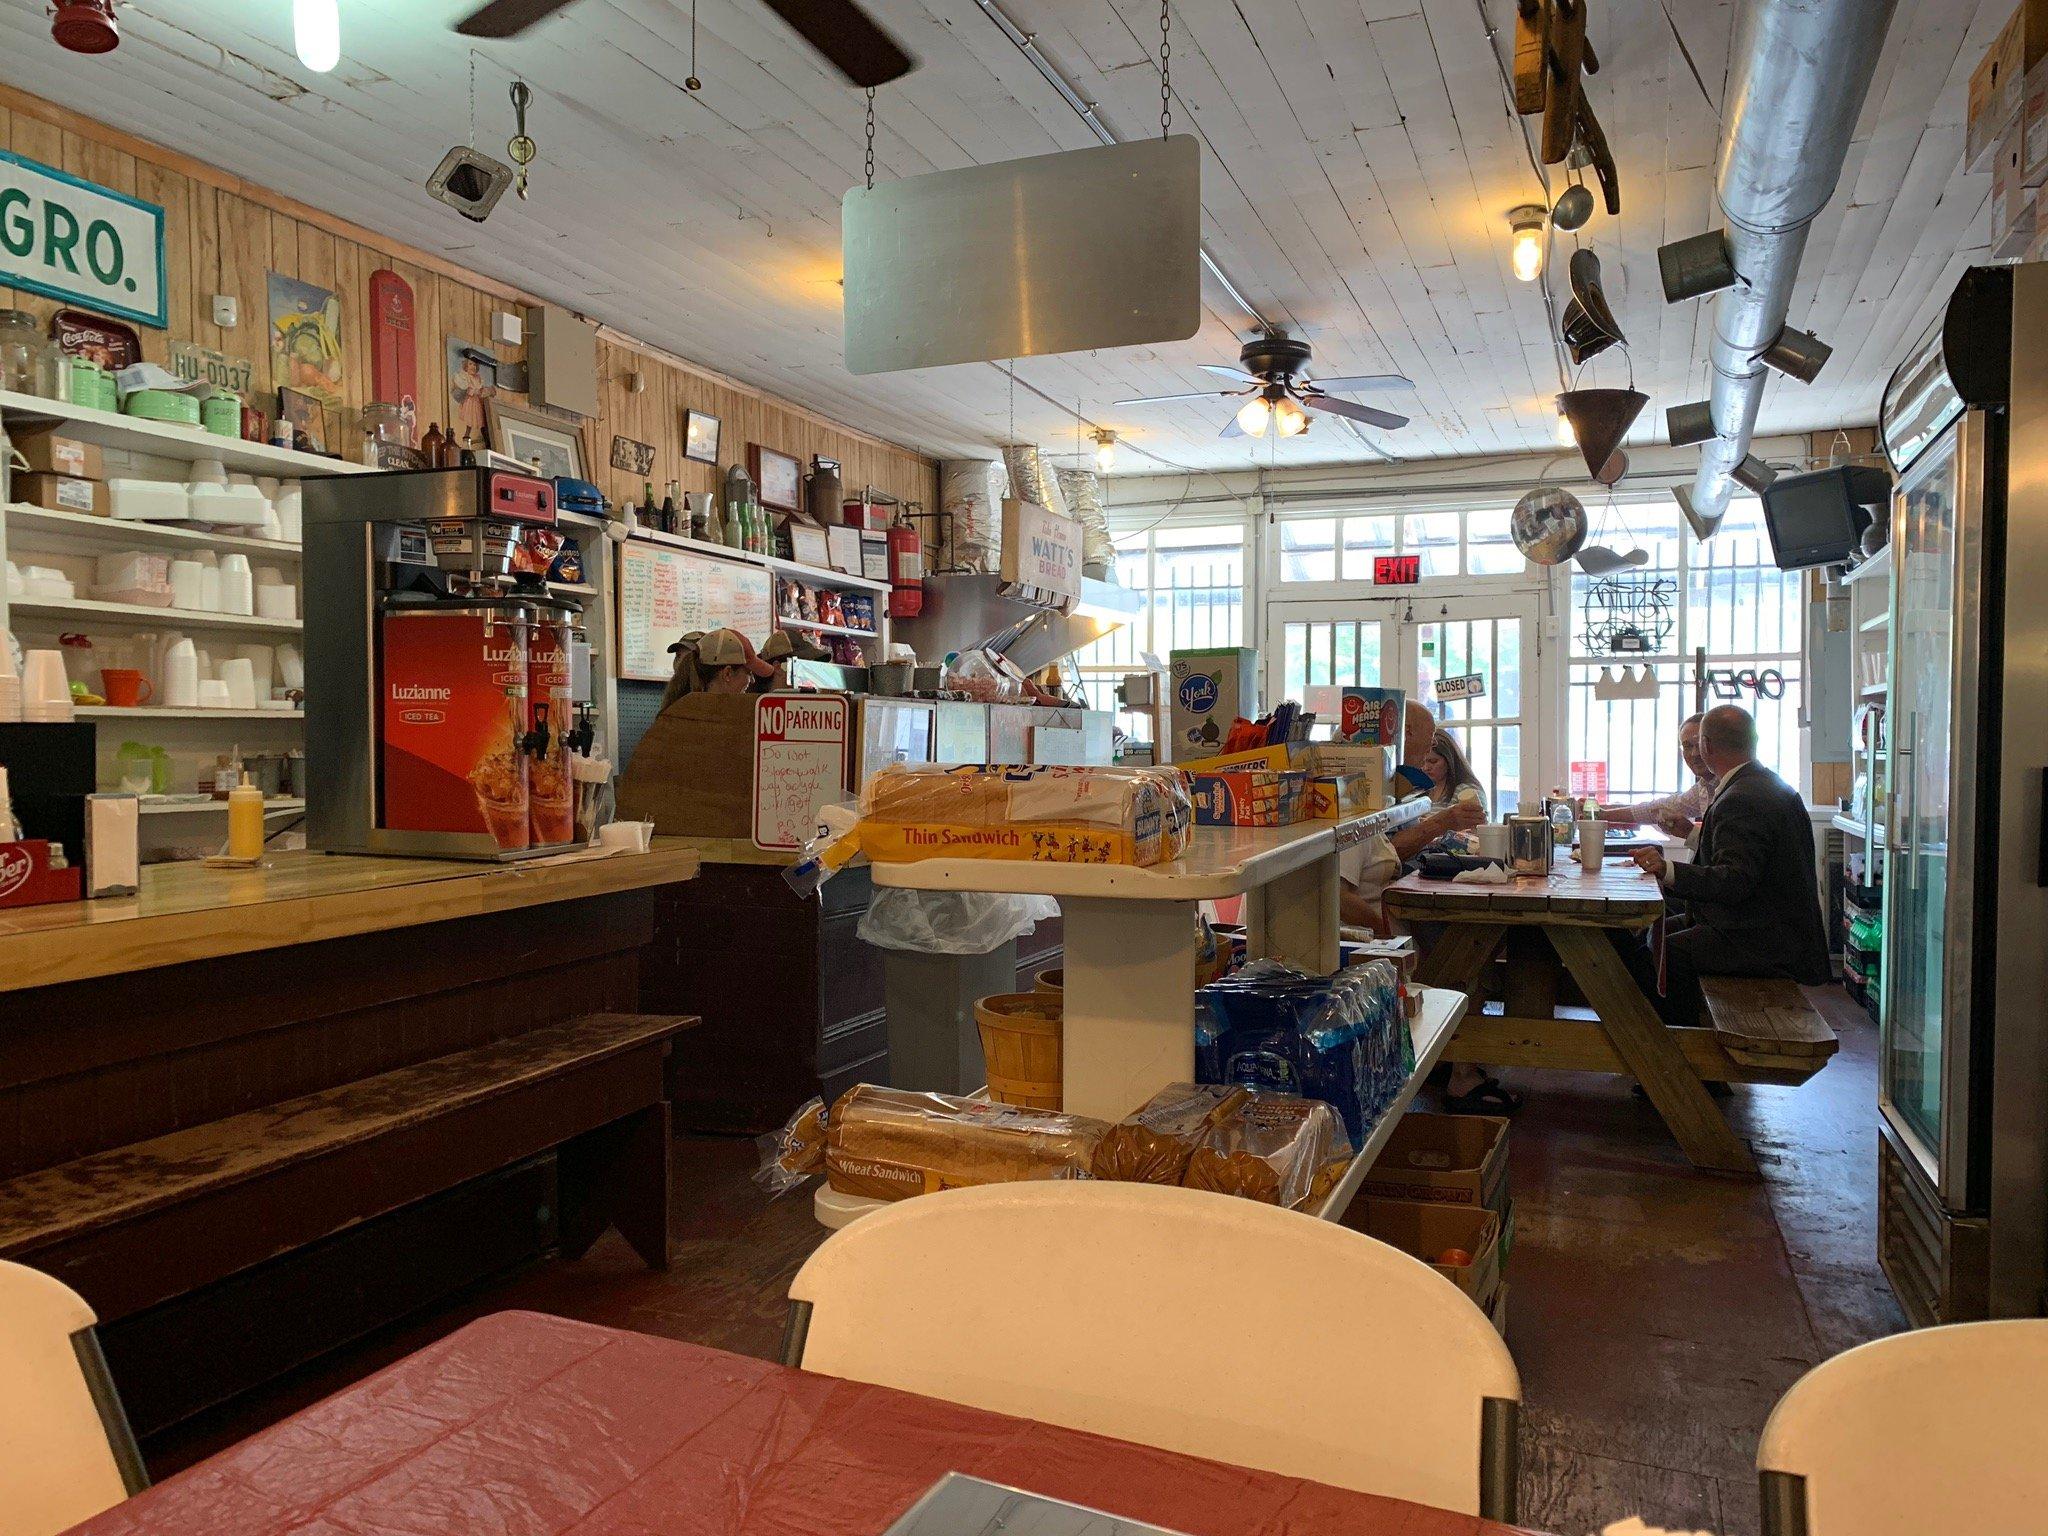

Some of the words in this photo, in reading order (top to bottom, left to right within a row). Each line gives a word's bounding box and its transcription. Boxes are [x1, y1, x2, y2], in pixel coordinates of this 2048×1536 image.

[0, 188, 137, 292] GRO.
[1032, 536, 1074, 568] WATT'S
[1039, 560, 1066, 579] BREAD
[1376, 557, 1418, 583] EXIT
[500, 675, 520, 683] ICED
[545, 675, 562, 684] ICED
[1436, 679, 1466, 694] CLOSED
[392, 684, 451, 700] Luzianne
[1180, 680, 1214, 712] York
[1363, 701, 1381, 711] AIR
[404, 712, 422, 720] ICED
[760, 706, 784, 735] NO
[785, 710, 842, 730] PARKING
[1352, 710, 1380, 724] HEADS
[902, 828, 937, 845] Thin
[942, 829, 1020, 846] Sandwich
[840, 1160, 871, 1176] Wheat
[872, 1165, 921, 1184] Sandwich
